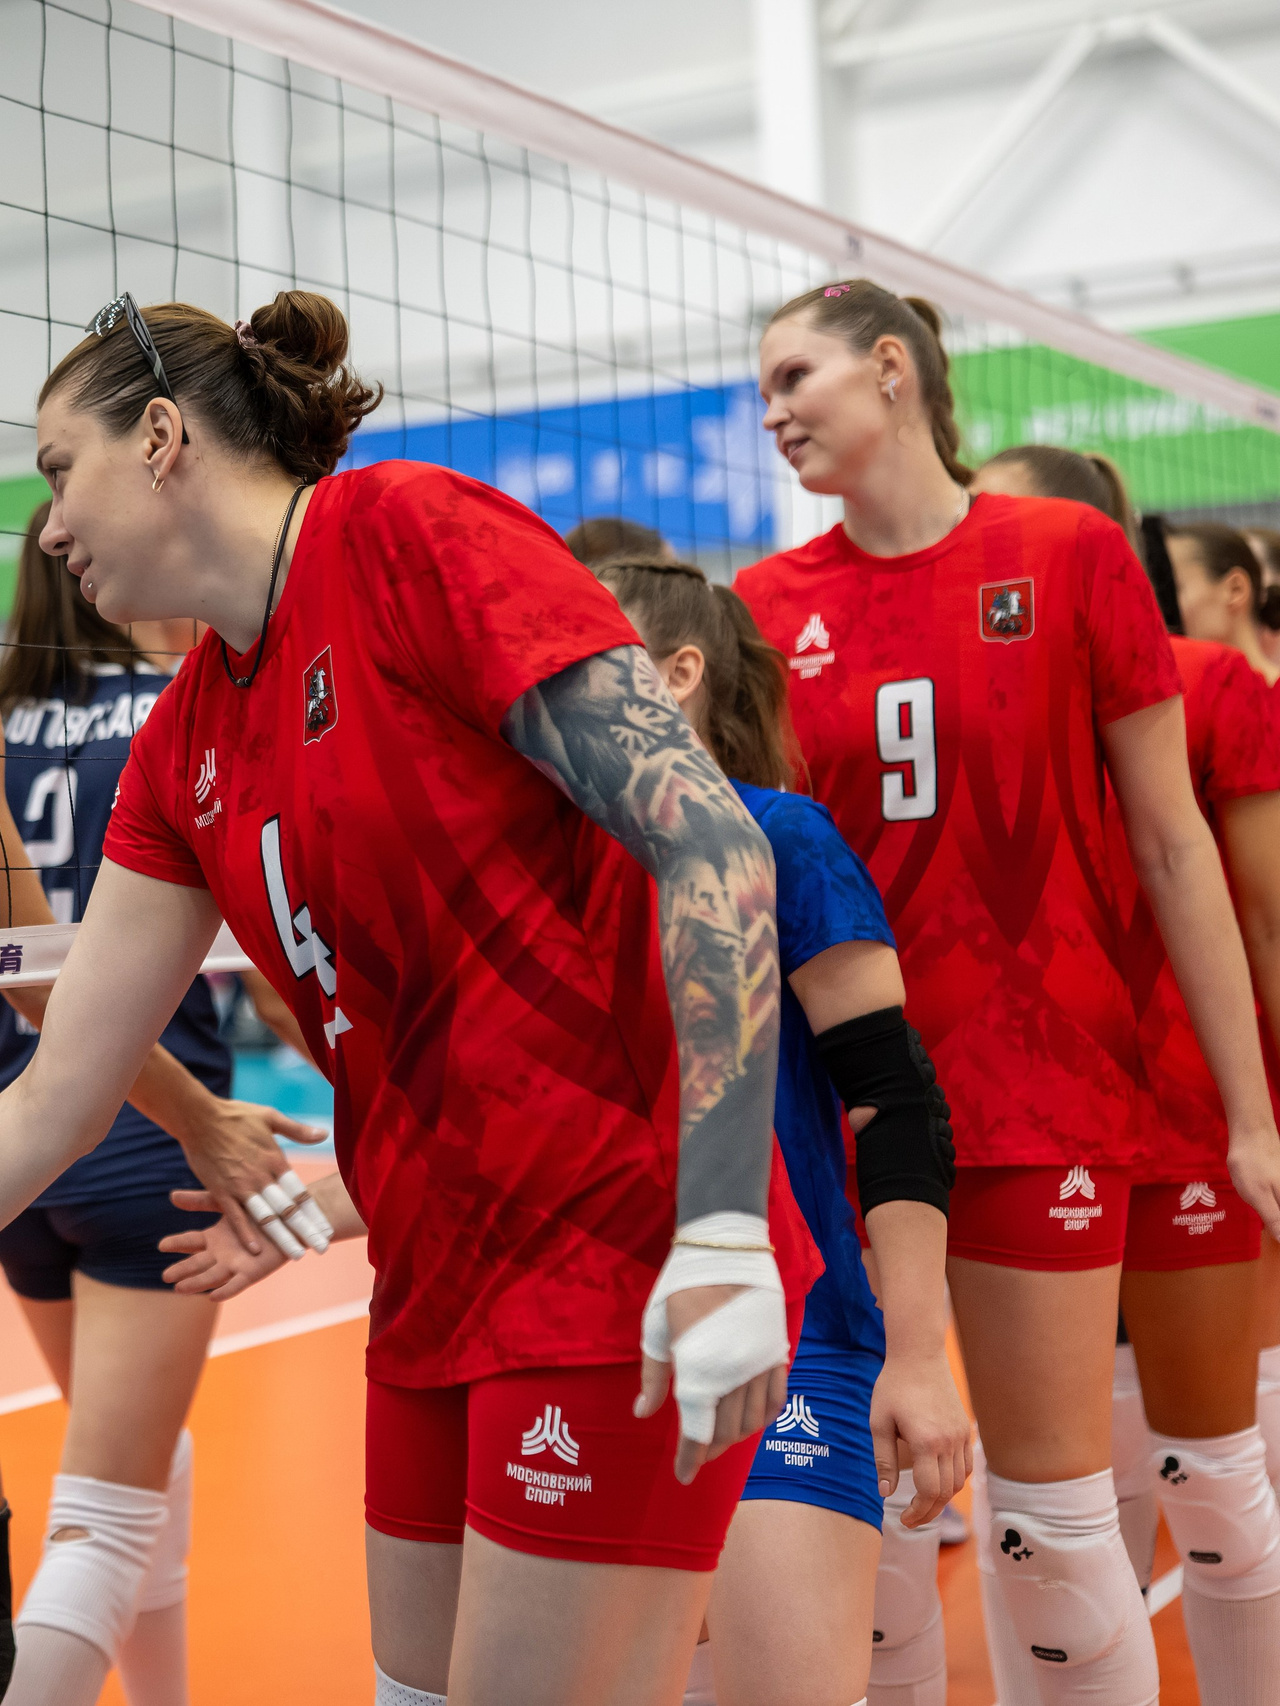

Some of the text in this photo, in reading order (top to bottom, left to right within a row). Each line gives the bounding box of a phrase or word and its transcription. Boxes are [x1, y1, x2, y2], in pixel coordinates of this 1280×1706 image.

[876, 677, 937, 822] 9
[260, 813, 354, 1050] 4
[765, 1439, 830, 1458] МОСКОВСКИЙ
[784, 1453, 814, 1468] СПОРТ
[506, 1461, 593, 1493] МОСКОВСКИЙ
[525, 1485, 566, 1507] СПОРТ
